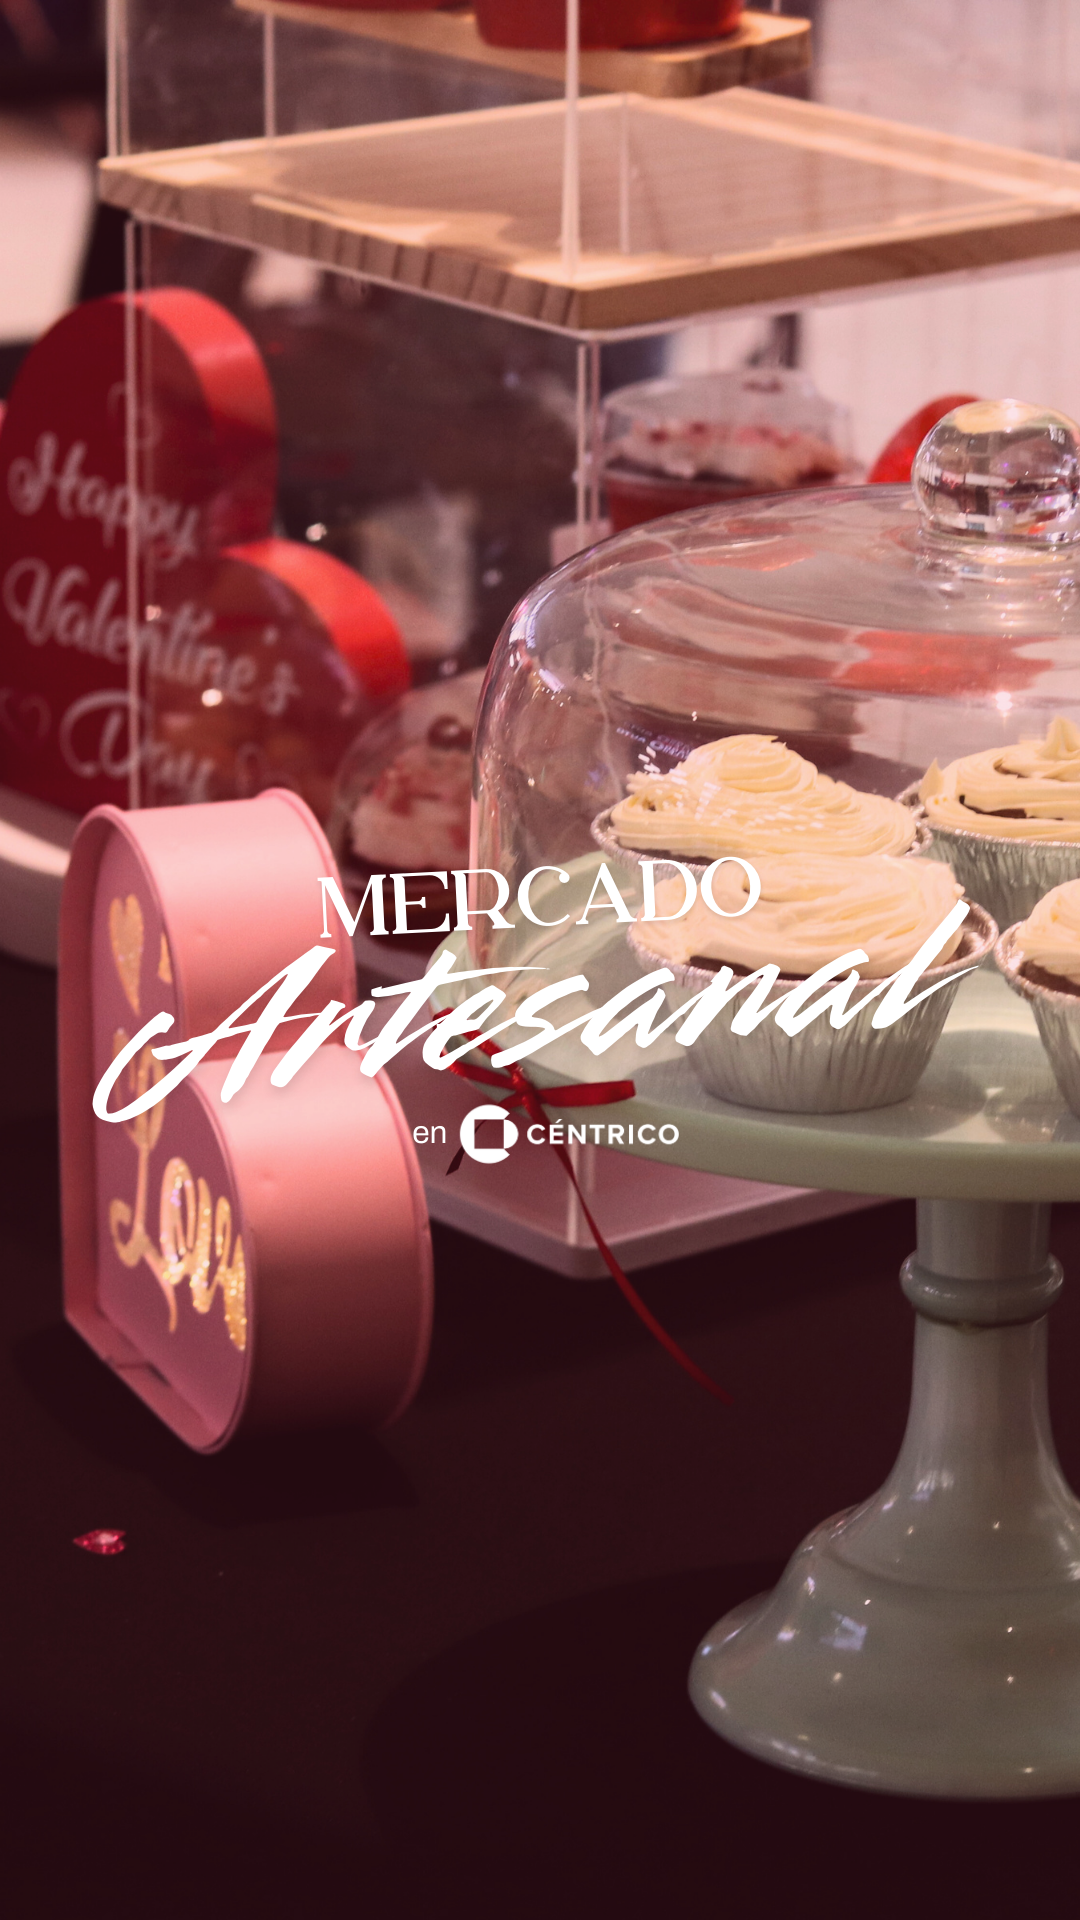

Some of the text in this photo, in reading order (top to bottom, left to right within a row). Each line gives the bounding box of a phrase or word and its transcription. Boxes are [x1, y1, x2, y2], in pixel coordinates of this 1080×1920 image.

[7, 430, 198, 570] Happy
[2, 556, 301, 716] Valentine's
[59, 687, 216, 802] Day
